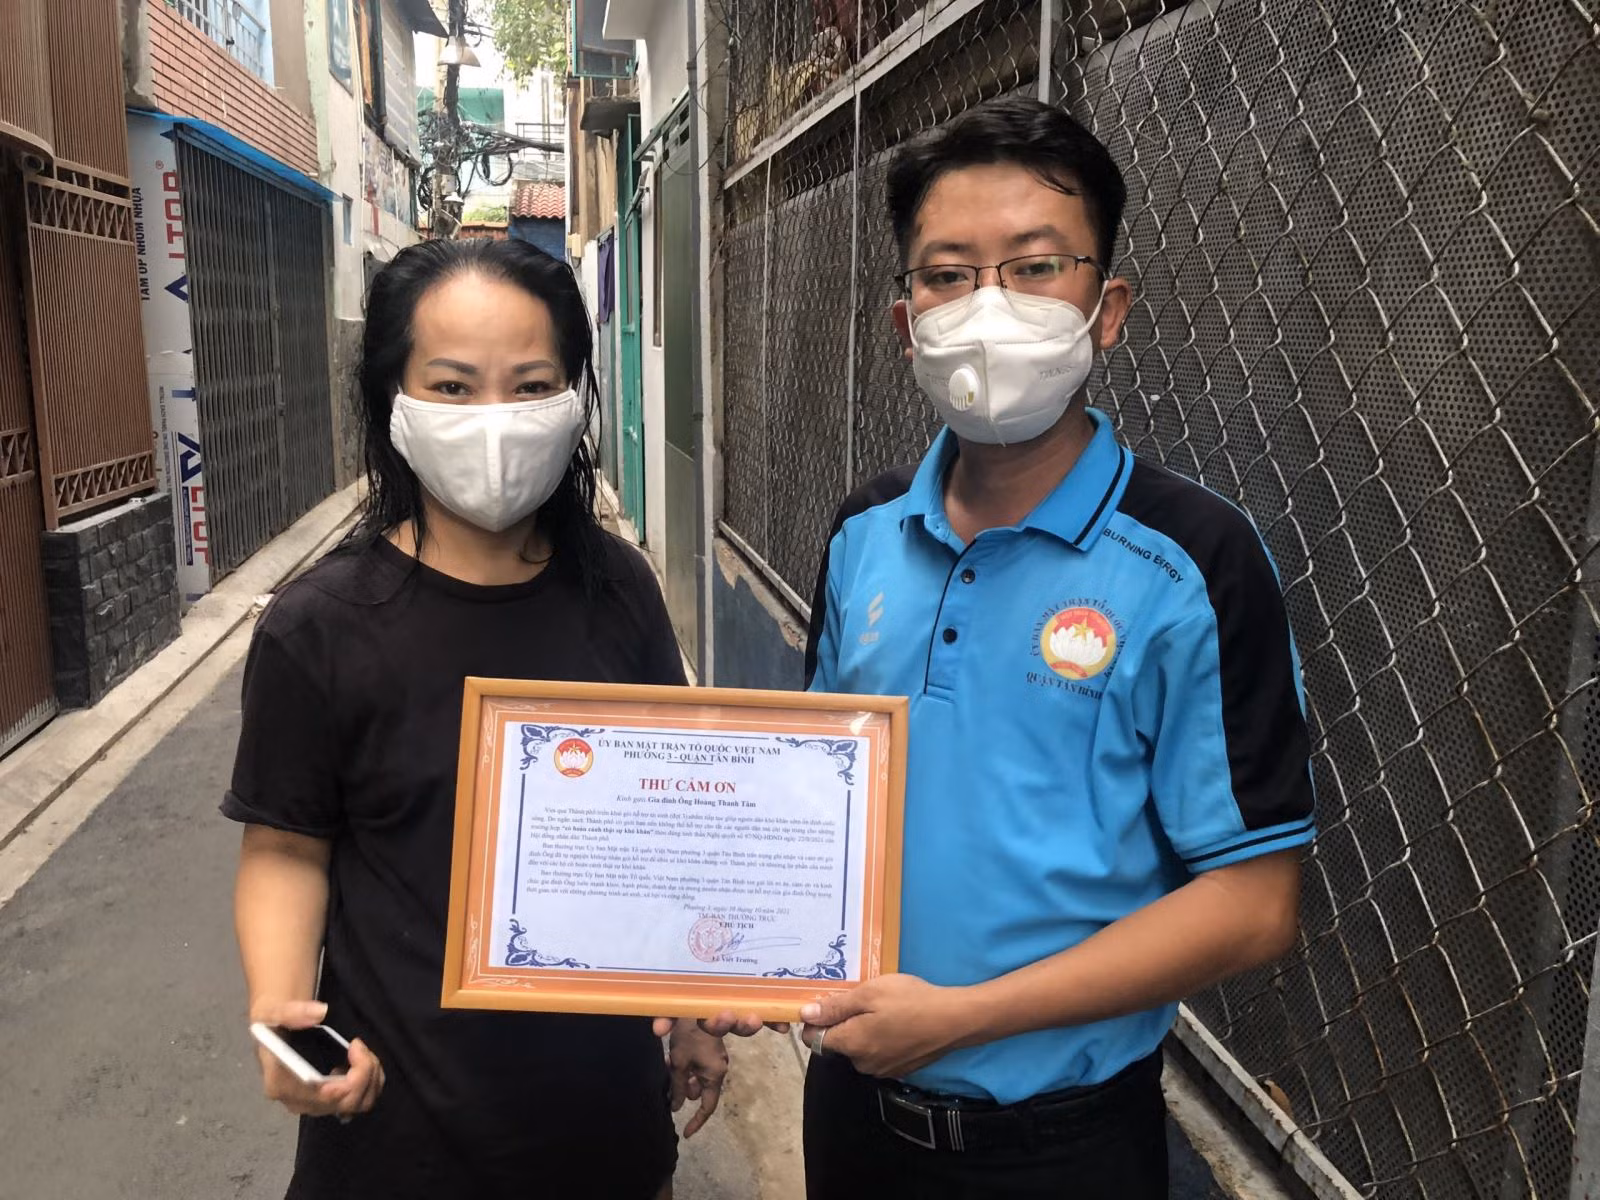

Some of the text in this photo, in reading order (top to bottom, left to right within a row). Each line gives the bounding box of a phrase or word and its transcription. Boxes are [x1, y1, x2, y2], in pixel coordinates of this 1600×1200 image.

[1103, 528, 1152, 560] BURNING
[598, 738, 780, 756] ỦY BAN MẶT TRẬN TỔ QUỐC VIỆT NAM
[624, 749, 665, 760] PHƯỜNG
[666, 752, 672, 760] 3
[679, 752, 707, 764] QUẬN
[710, 752, 728, 762] TÂN
[731, 754, 754, 764] BÌNH
[639, 776, 736, 794] THƯ CẢM ƠN
[678, 796, 692, 806] Ông
[718, 799, 739, 807] Thanh
[740, 800, 756, 808] Tâm
